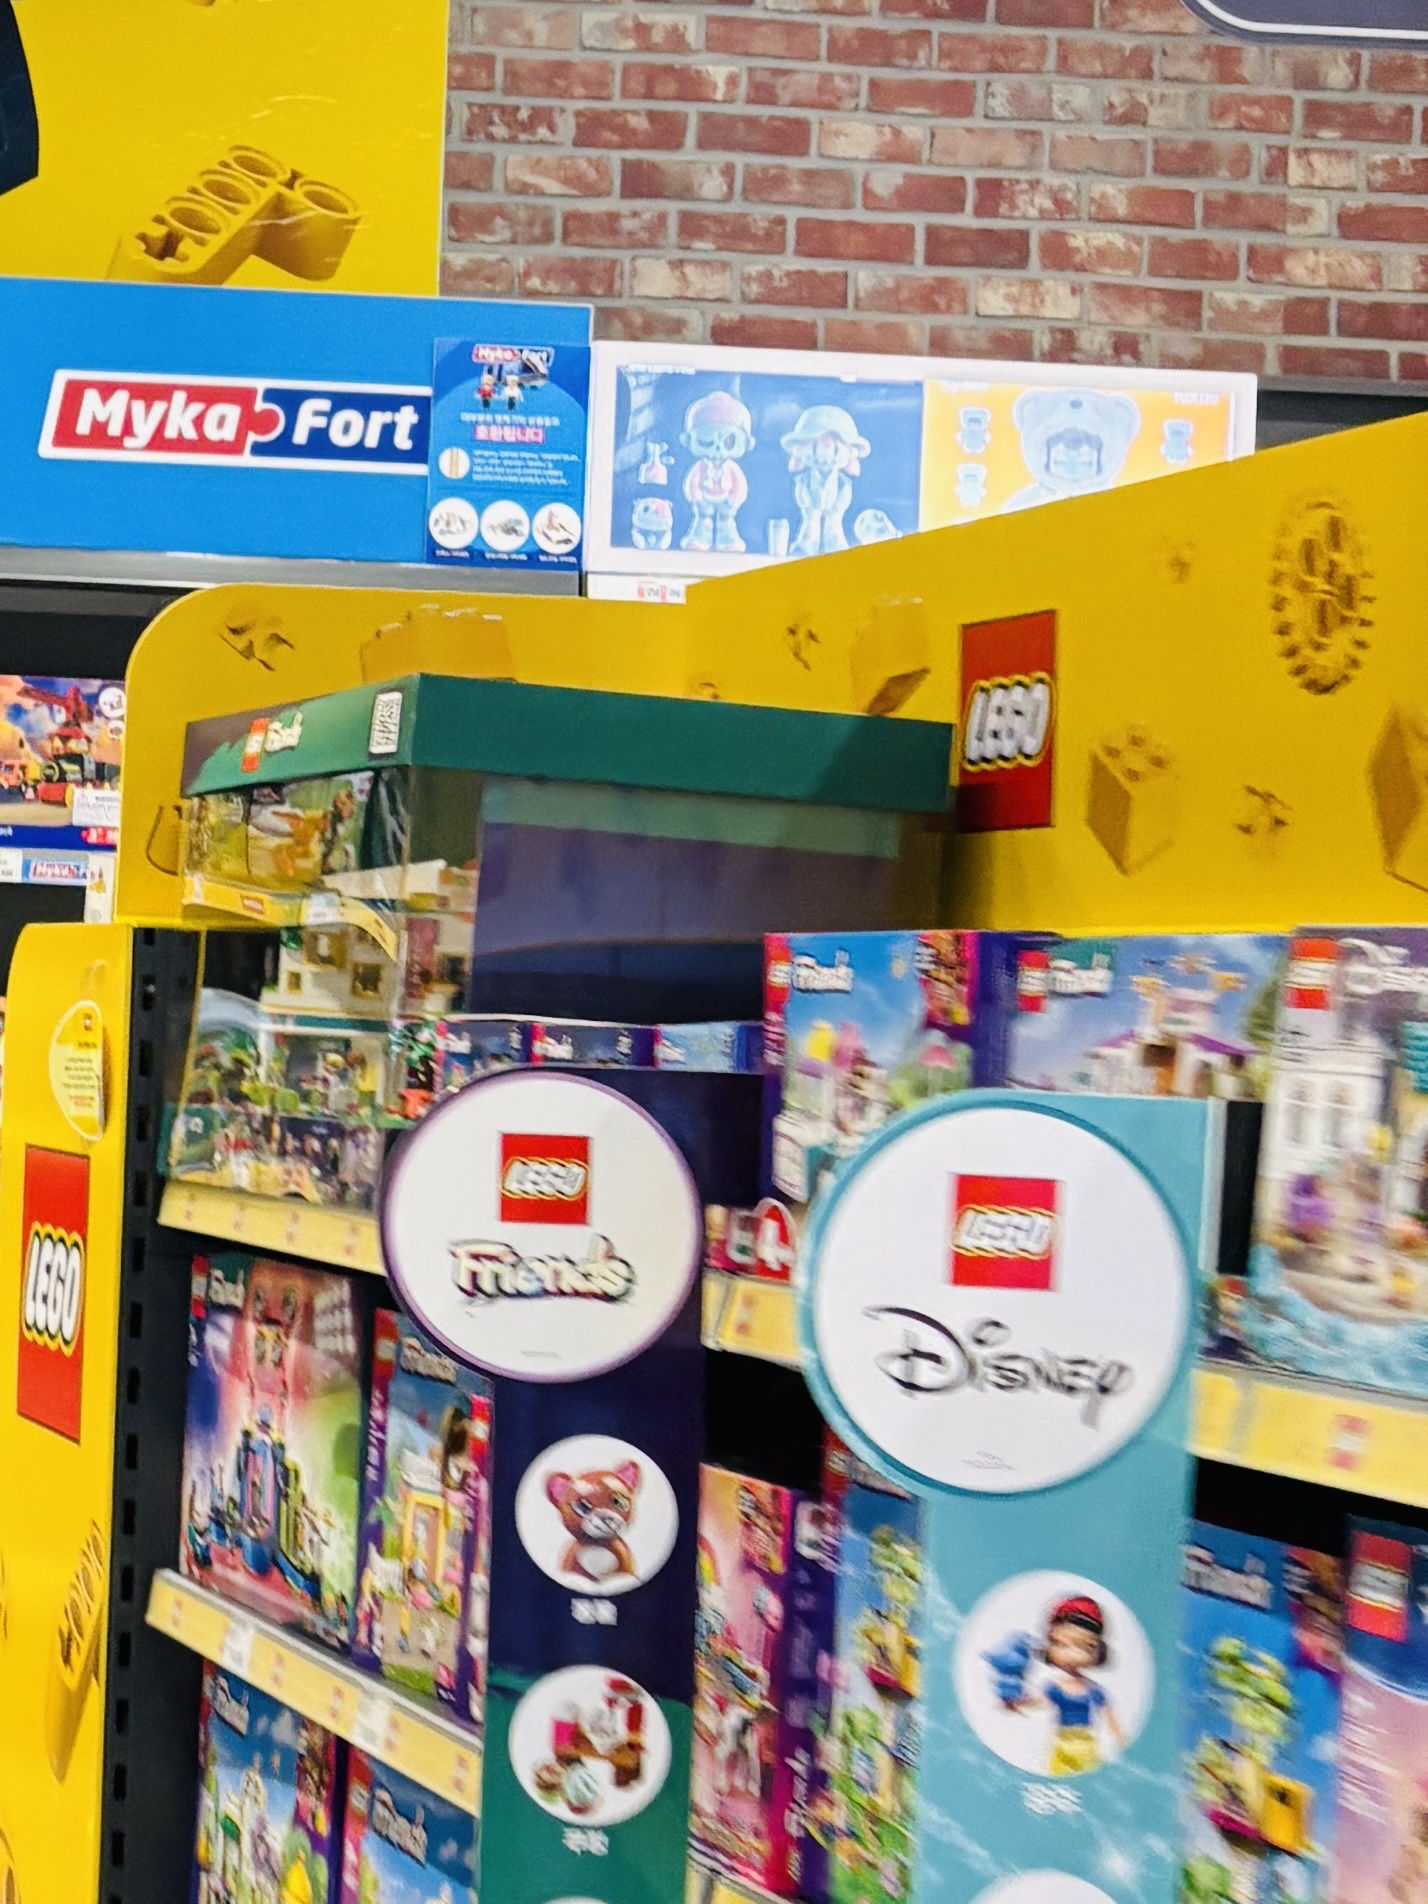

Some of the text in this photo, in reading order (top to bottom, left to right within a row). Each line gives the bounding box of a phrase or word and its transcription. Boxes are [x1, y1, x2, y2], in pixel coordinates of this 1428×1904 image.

[75, 387, 419, 451] Myka Fort
[964, 681, 1051, 765] LEGO
[24, 1236, 82, 1344] LEGO
[863, 1304, 1136, 1430] Disney
